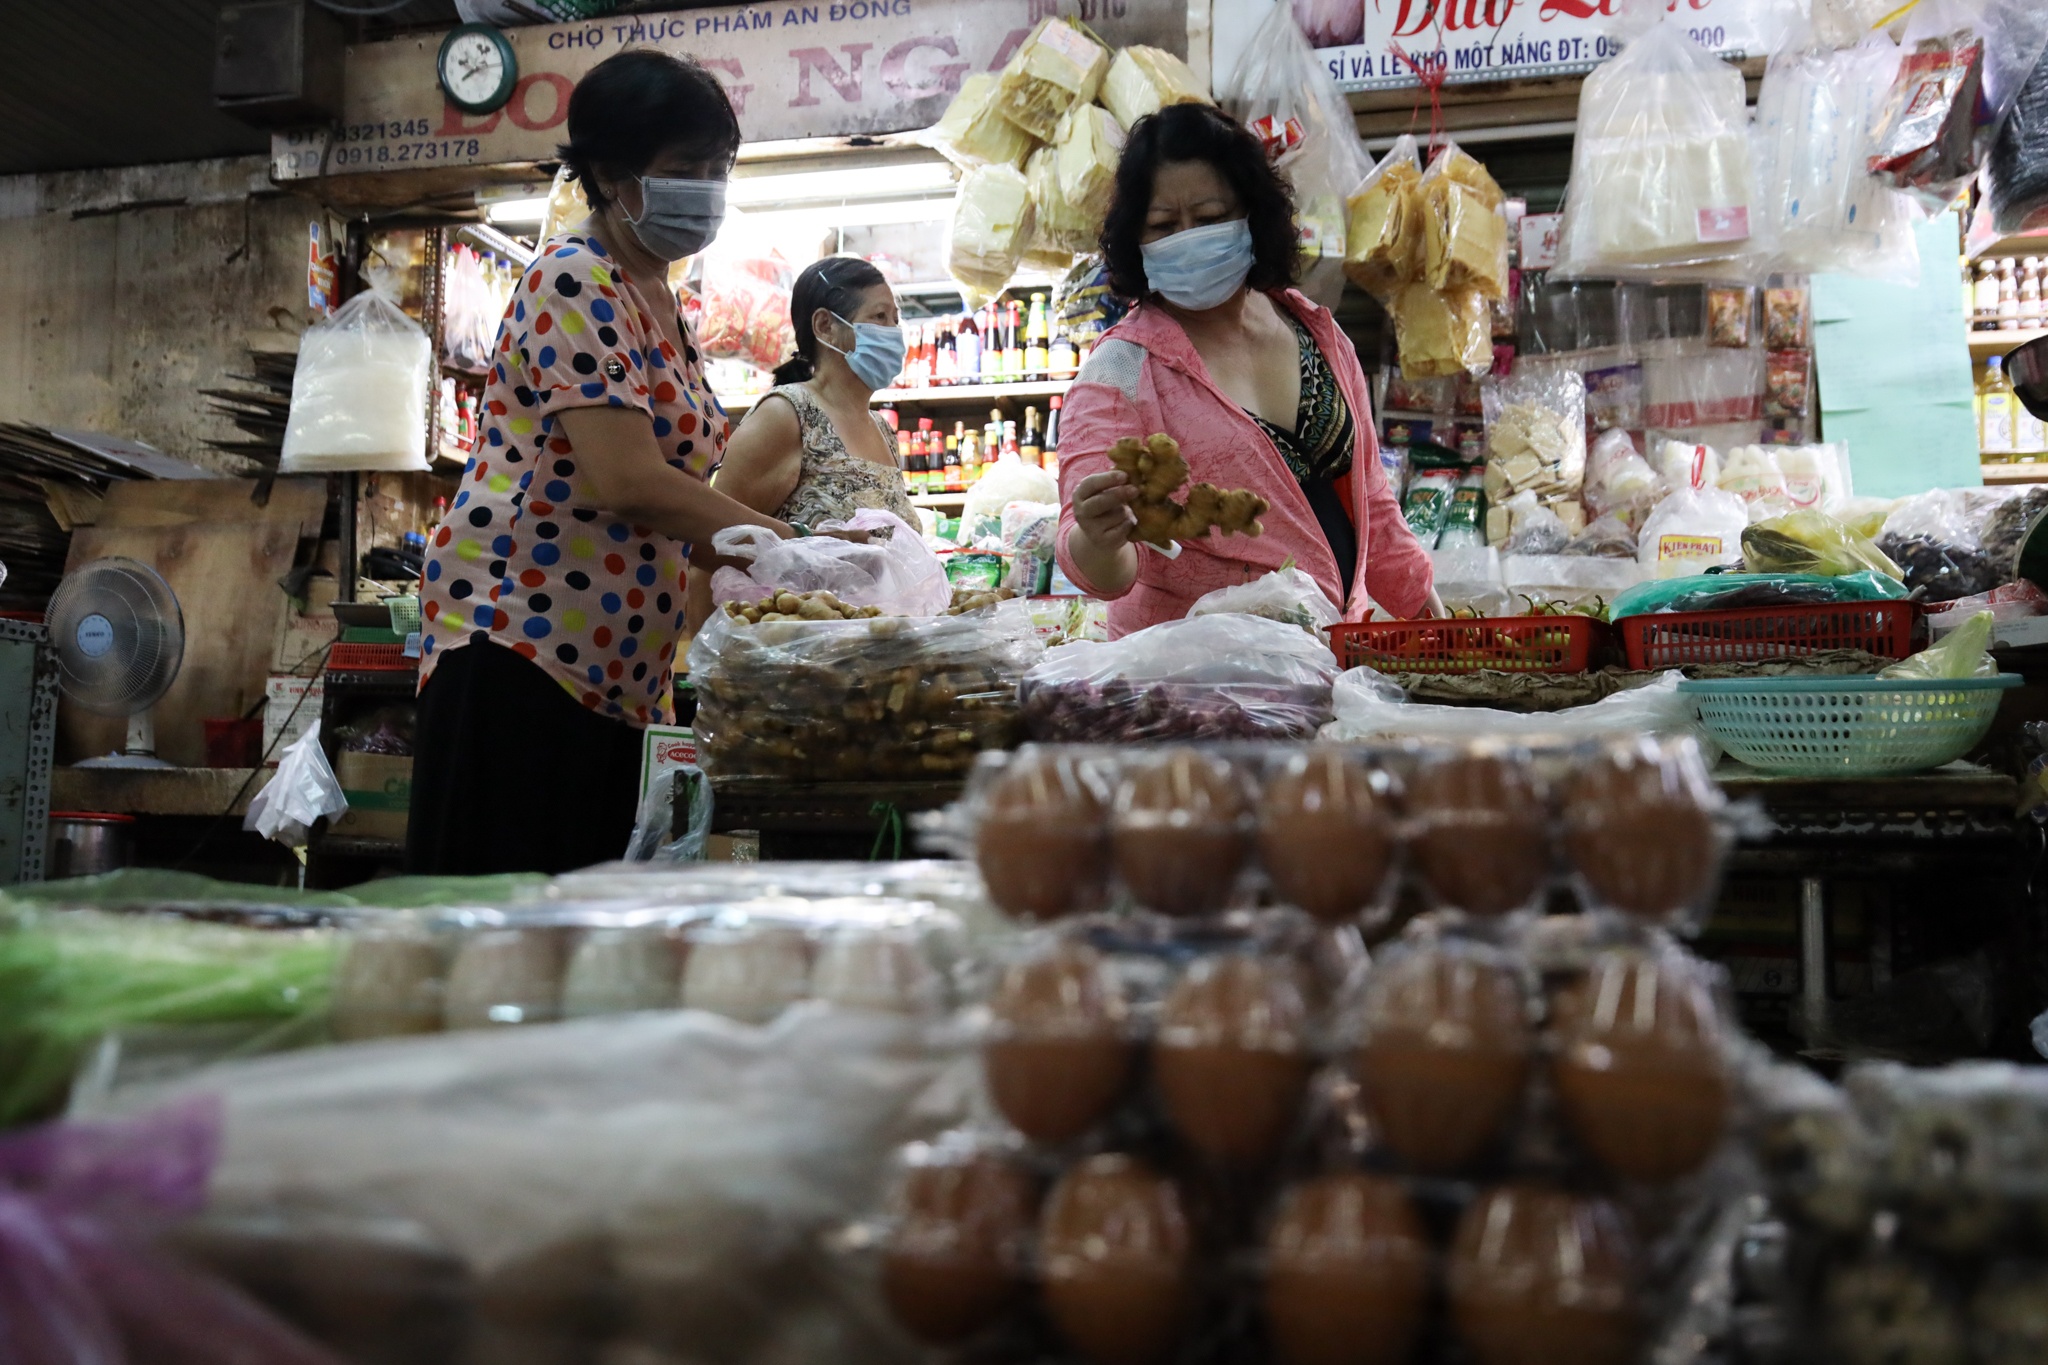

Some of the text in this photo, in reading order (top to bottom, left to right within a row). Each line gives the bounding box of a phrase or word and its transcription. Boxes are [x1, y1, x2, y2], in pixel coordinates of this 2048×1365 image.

[548, 24, 603, 49] CHỢ
[612, 19, 685, 44] THỰC
[782, 6, 819, 26] AN
[1351, 50, 1374, 79] VÀ
[1501, 32, 1551, 66] NẮNG
[1558, 36, 1588, 60] ĐT:
[336, 139, 480, 166] 0918.273178
